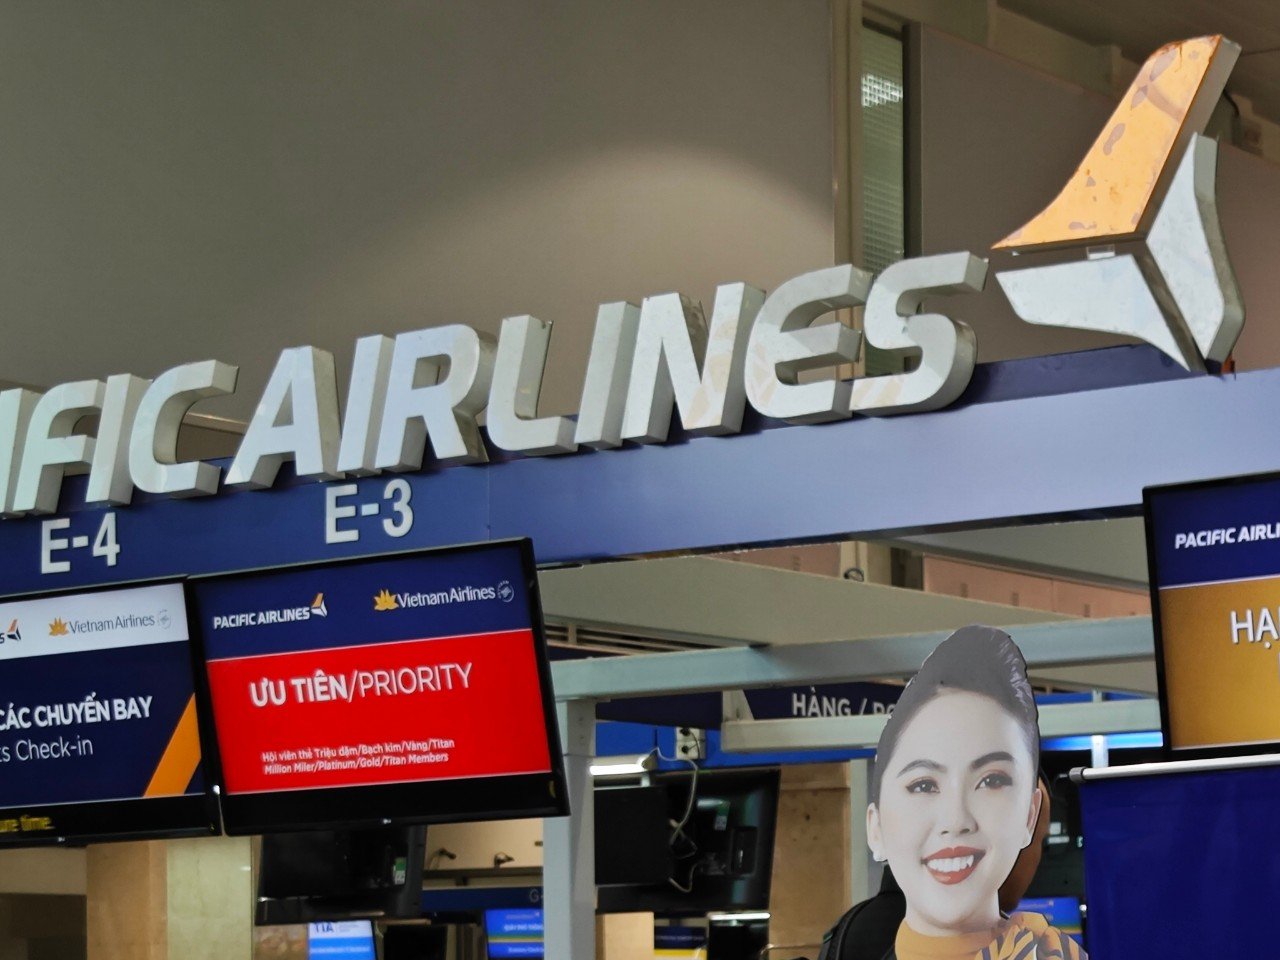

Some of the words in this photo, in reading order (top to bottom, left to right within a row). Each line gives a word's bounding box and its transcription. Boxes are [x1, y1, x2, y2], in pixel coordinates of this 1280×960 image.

[225, 251, 988, 488] AIRLINES
[325, 478, 414, 545] E-3
[41, 512, 121, 574] E-4
[1174, 527, 1236, 550] PACIFIC
[397, 592, 449, 609] Vietnam
[449, 584, 496, 602] Airlines
[68, 619, 115, 634] Vietnam
[115, 614, 155, 629] Airlines
[213, 612, 256, 629] PACIFIC
[257, 606, 310, 624] AIRLINES
[250, 676, 286, 708] ƯU
[291, 661, 472, 703] TIÊN/PRIORITY
[114, 695, 153, 721] BAY
[15, 735, 94, 762] Check-in
[408, 752, 449, 764] Members
